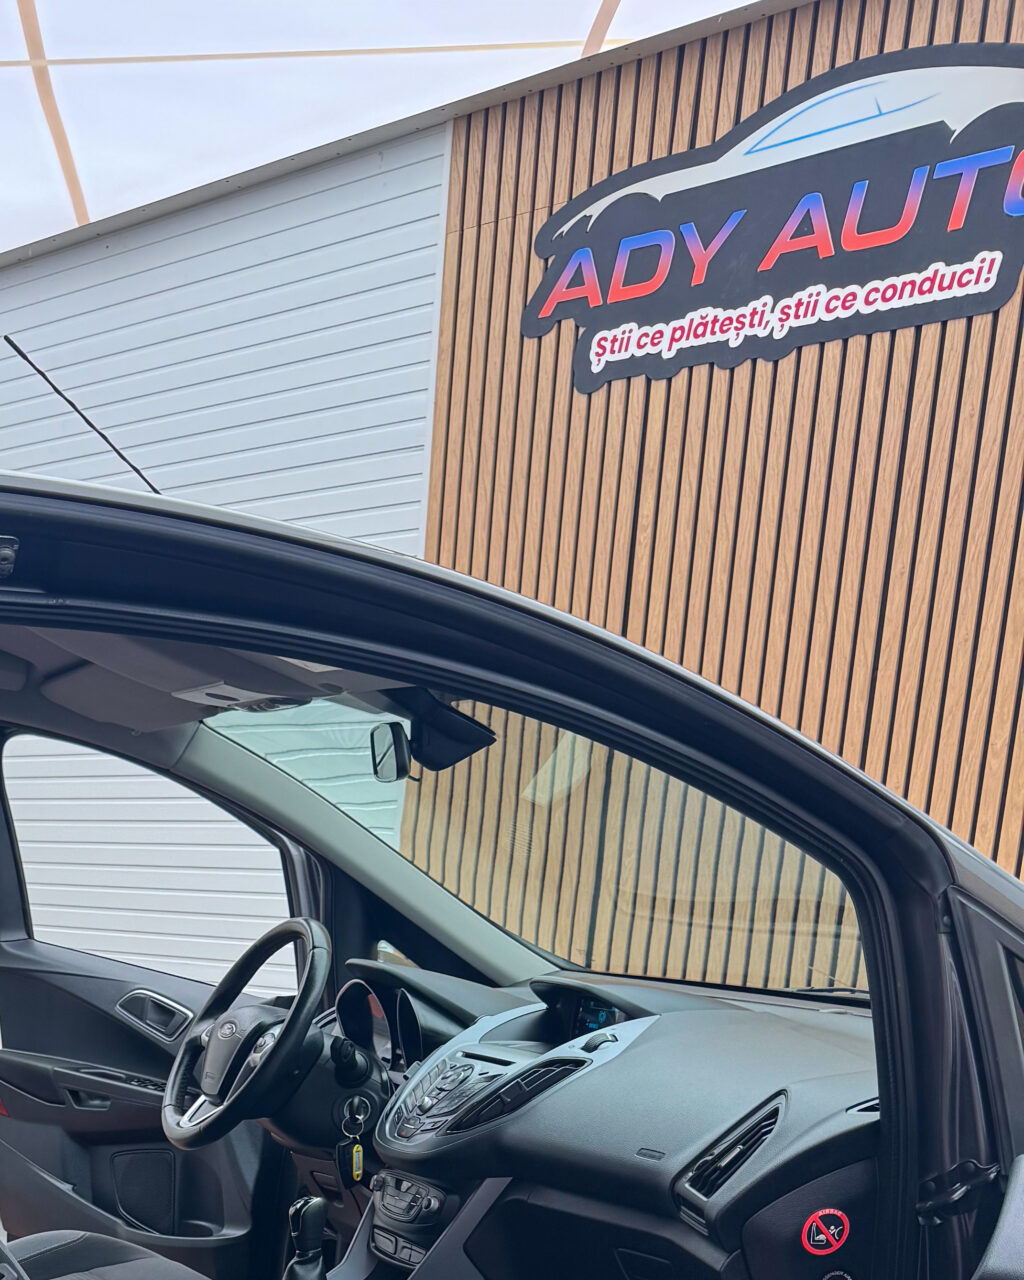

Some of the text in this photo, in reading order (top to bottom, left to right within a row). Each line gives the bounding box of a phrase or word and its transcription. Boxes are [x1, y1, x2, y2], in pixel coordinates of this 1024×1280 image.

[538, 145, 1024, 318] ADY AUT
[636, 327, 664, 350] ce
[667, 301, 770, 352] plătești,
[777, 291, 820, 333] știi
[825, 291, 857, 315] ce
[867, 256, 996, 309] conduci!
